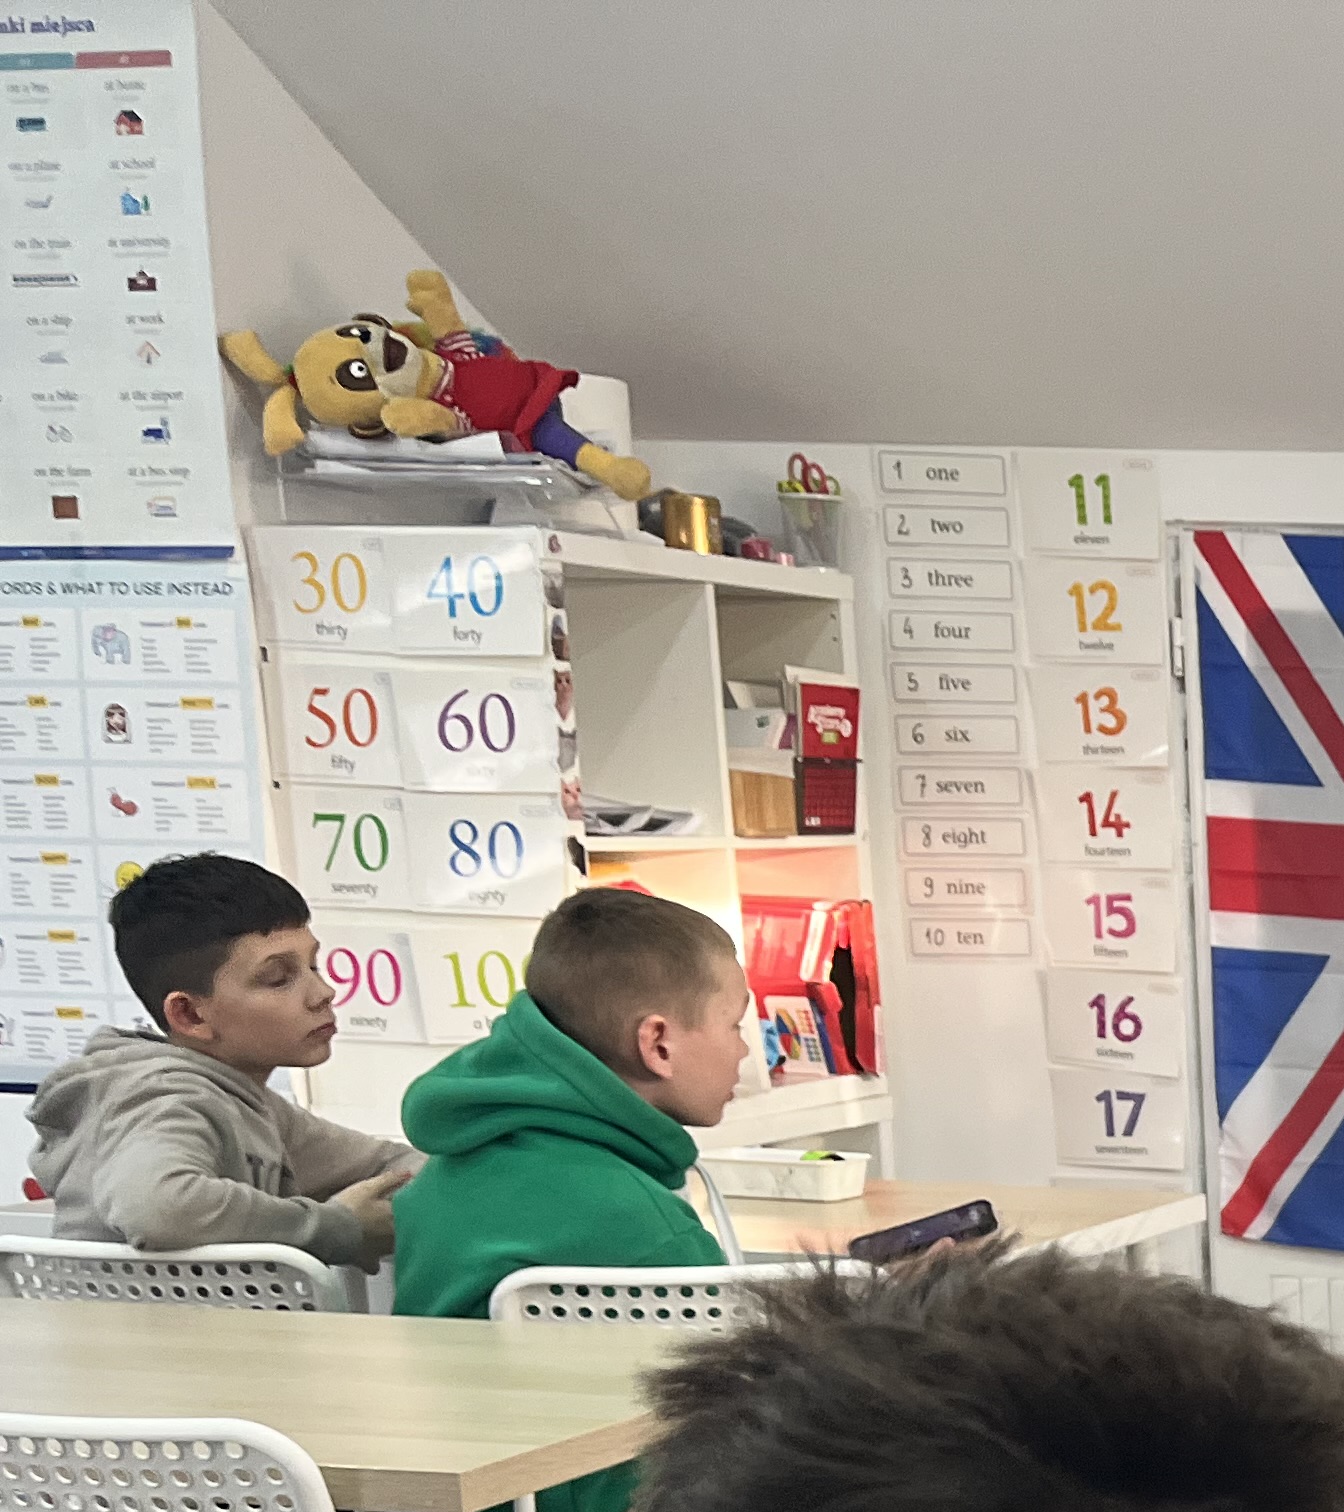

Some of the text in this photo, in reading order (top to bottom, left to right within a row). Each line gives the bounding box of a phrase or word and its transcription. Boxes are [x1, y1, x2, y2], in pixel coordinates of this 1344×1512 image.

[31, 16, 95, 37] miejsca
[892, 460, 960, 481] 1 one
[1068, 473, 1113, 526] 11
[897, 514, 964, 536] 2 two
[1074, 531, 1110, 545] eleven
[47, 581, 58, 596] &
[62, 581, 104, 596] WHAT
[109, 581, 129, 596] TO
[133, 581, 163, 596] USE
[168, 581, 233, 597] INSTEAD
[291, 551, 368, 614] 30
[427, 555, 504, 619] 40
[900, 567, 974, 589] 3 three
[1067, 579, 1123, 633] 12
[316, 622, 348, 641] thirty
[903, 616, 972, 639] 4 four
[1079, 639, 1115, 652] twelve
[906, 671, 973, 692] 5 five
[305, 687, 378, 748] 50
[437, 689, 516, 753] 60
[1074, 686, 1128, 737] 13
[911, 722, 970, 745] 6 six
[1082, 744, 1126, 756] thirteen
[331, 754, 356, 772] fifty
[915, 774, 985, 797] 7 seven
[1079, 789, 1131, 838] 14
[312, 813, 389, 873] 70
[921, 824, 987, 848] 8 eight
[449, 819, 524, 879] 80
[1084, 843, 1132, 857] fourteen
[331, 881, 378, 897] seventy
[924, 877, 986, 898] 9 nine
[1084, 892, 1137, 940] 15
[925, 928, 985, 946] 10 ten
[1093, 944, 1128, 958] fifteen
[326, 947, 402, 1007] 90
[443, 950, 531, 1008] 10
[350, 1015, 387, 1031] ninety
[1088, 993, 1143, 1043] 16
[1095, 1089, 1146, 1137] 17
